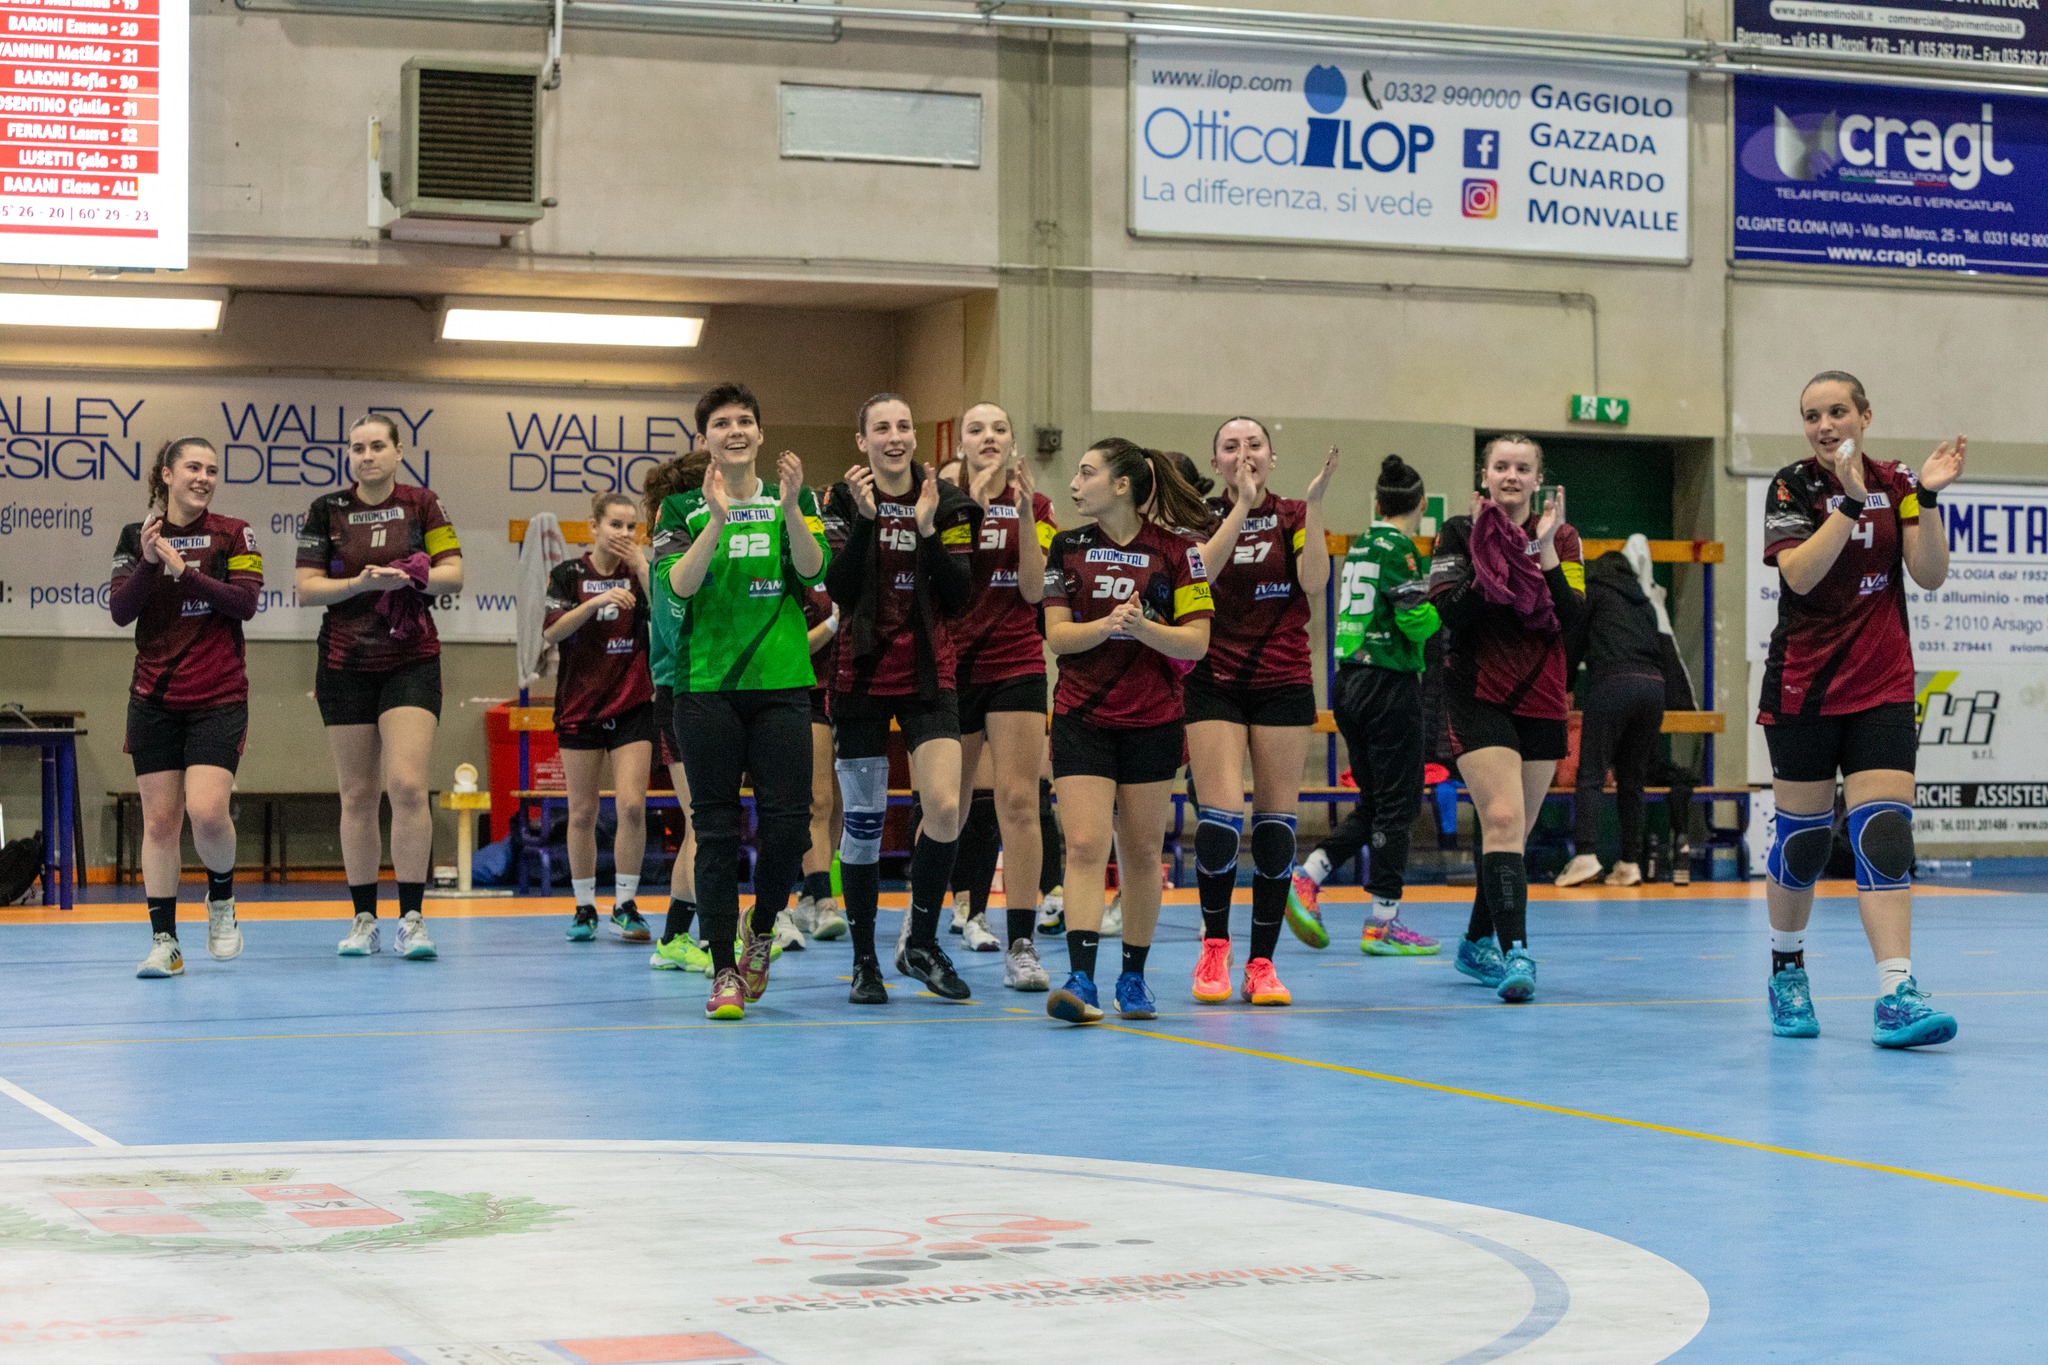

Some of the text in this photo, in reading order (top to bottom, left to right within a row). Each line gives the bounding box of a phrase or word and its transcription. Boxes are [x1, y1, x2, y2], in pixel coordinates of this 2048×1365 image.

[8, 16, 138, 36] BARONI Emma 20
[56, 45, 112, 62] Matilde
[122, 48, 138, 63] 21
[14, 70, 138, 91] BARONI Sofia 30
[1152, 69, 1292, 92] www.ilop.com
[68, 98, 110, 117] Giulia
[122, 102, 138, 116] 31
[1384, 81, 1522, 110] 0332 990000
[1531, 84, 1674, 118] GAGGIOLO
[7, 122, 67, 140] FERRARI
[70, 125, 109, 142] Laura
[1144, 107, 1298, 166] Ottica
[1530, 122, 1657, 156] GAZZADA
[1838, 103, 2014, 190] cragi
[19, 150, 138, 170] LUSETTI Gaia 33
[4, 176, 138, 196] BARANI Elena ALL
[1528, 160, 1665, 194] CUNARDO
[1143, 174, 1175, 202] La
[1336, 187, 1357, 212] si
[1364, 191, 1433, 217] vede
[1812, 189, 1840, 202] PER
[1841, 191, 1912, 206] GALVANICA
[19, 206, 34, 217] 26
[49, 207, 64, 218] 20
[106, 210, 120, 220] 29
[136, 210, 149, 221] 23
[1528, 199, 1679, 232] MONVALLE
[1736, 216, 1786, 233] OLGIATE
[1788, 218, 1830, 235] OLONA
[1830, 220, 1854, 239] (VA)
[1862, 223, 1880, 238] Via
[1881, 224, 1902, 239] San
[1941, 228, 1956, 242] 25
[1826, 246, 1966, 268] www.cragi.com
[221, 402, 434, 446] WALLY
[507, 412, 696, 454] WALLEY
[0, 438, 141, 481] SIGN
[224, 444, 430, 488] DESIN
[725, 509, 772, 522] VIOMETAL
[880, 528, 917, 551] 49
[980, 529, 1008, 550] 31
[1852, 522, 1874, 548] 4
[1938, 503, 2048, 554] META
[728, 533, 770, 558] 92
[1234, 542, 1272, 564] 27
[1090, 550, 1143, 566] AVIOMETAL
[1092, 575, 1135, 600] 30
[1924, 591, 1938, 603] di
[1942, 592, 2010, 604] alluminio
[1914, 615, 2043, 635] 15 21010 Arsago
[1914, 785, 1962, 806] RCHE
[712, 1263, 1365, 1306] PALLAMANO FEMMINILE
[736, 1294, 982, 1314] CASSANO
[988, 1280, 1248, 1300] MAGNAGO
